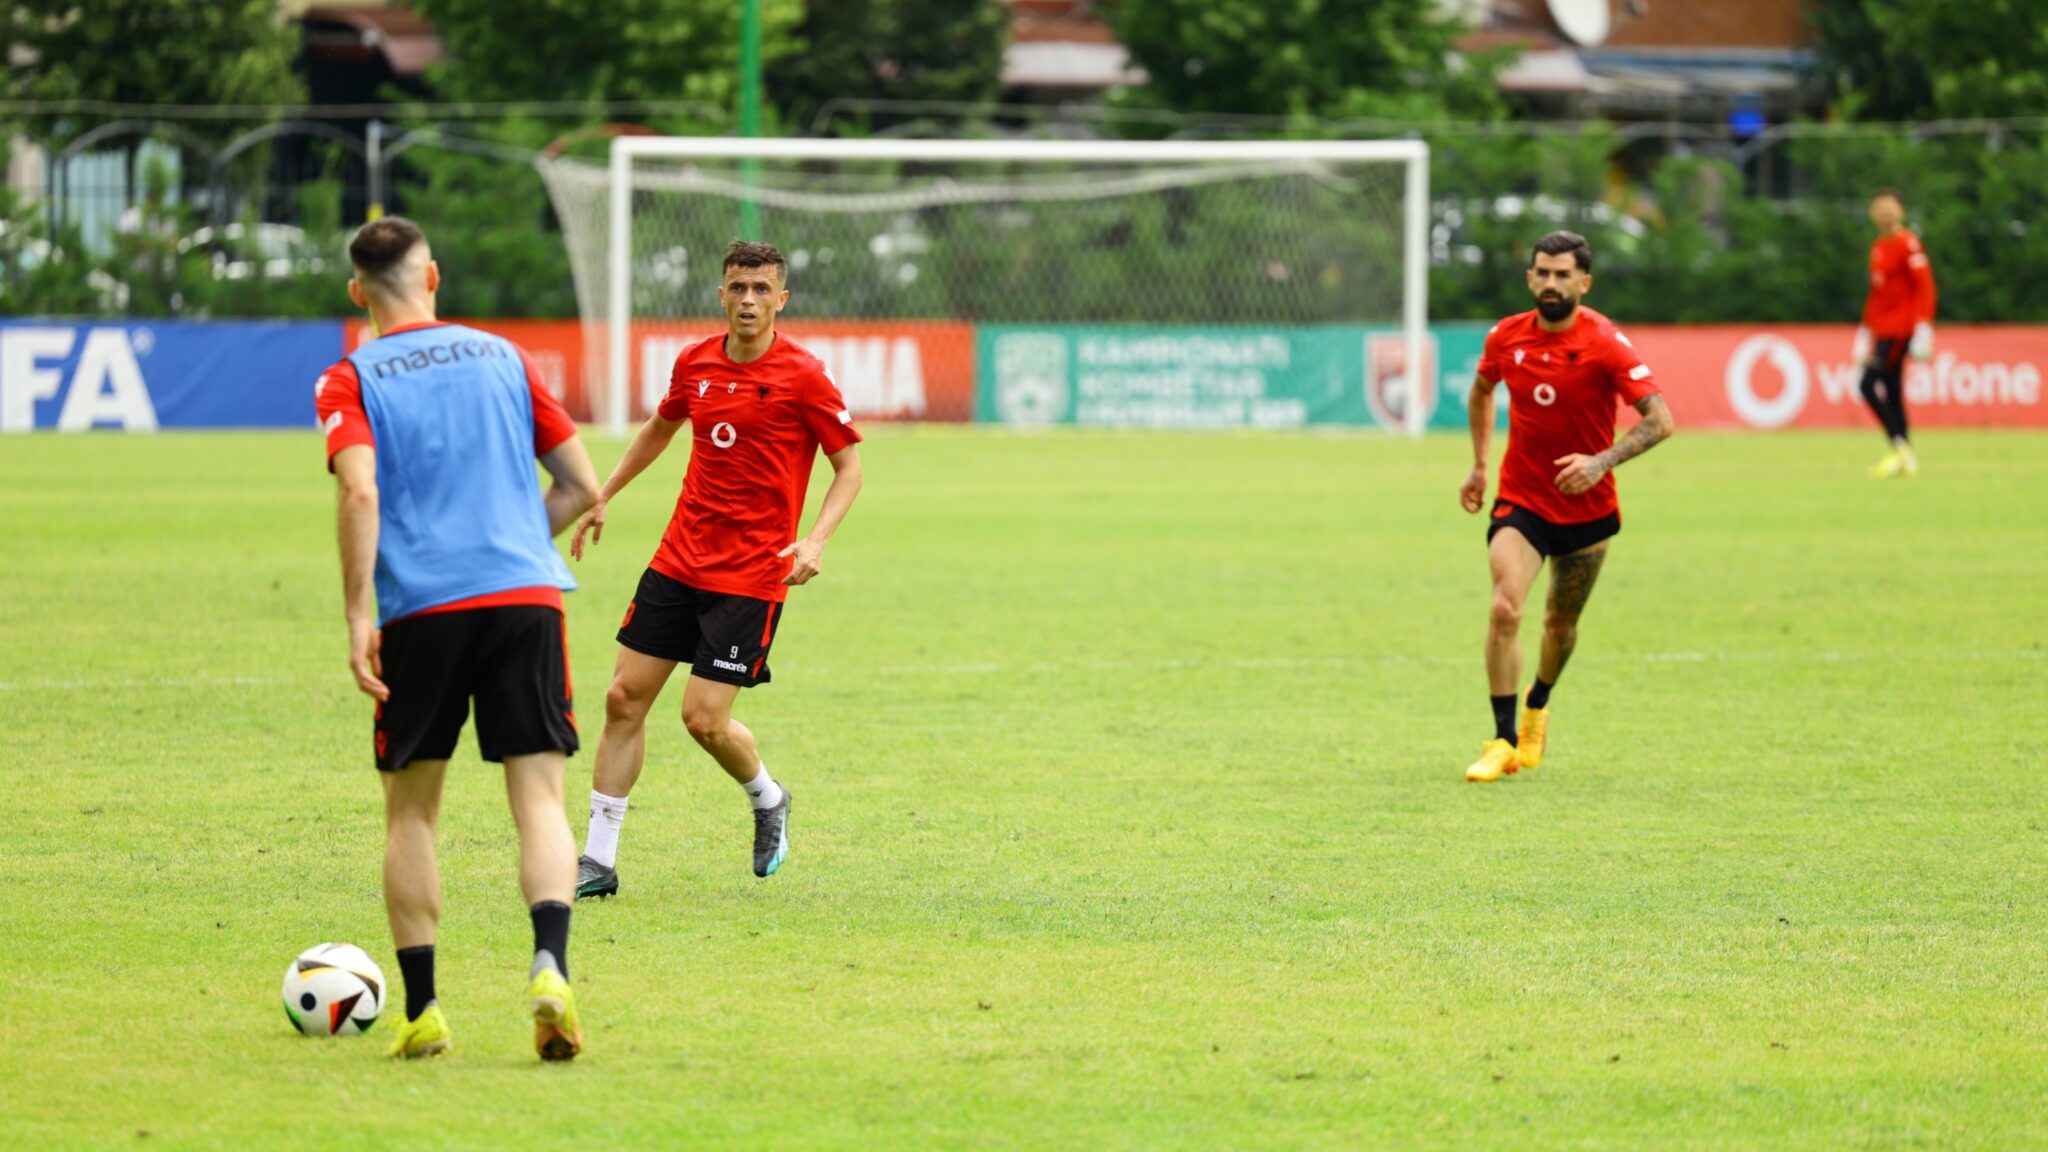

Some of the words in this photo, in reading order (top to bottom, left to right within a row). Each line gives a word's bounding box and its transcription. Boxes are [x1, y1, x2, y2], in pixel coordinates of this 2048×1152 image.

[373, 340, 508, 379] macron
[1818, 350, 2040, 405] vafone
[730, 645, 739, 659] 9
[713, 659, 747, 674] macron
